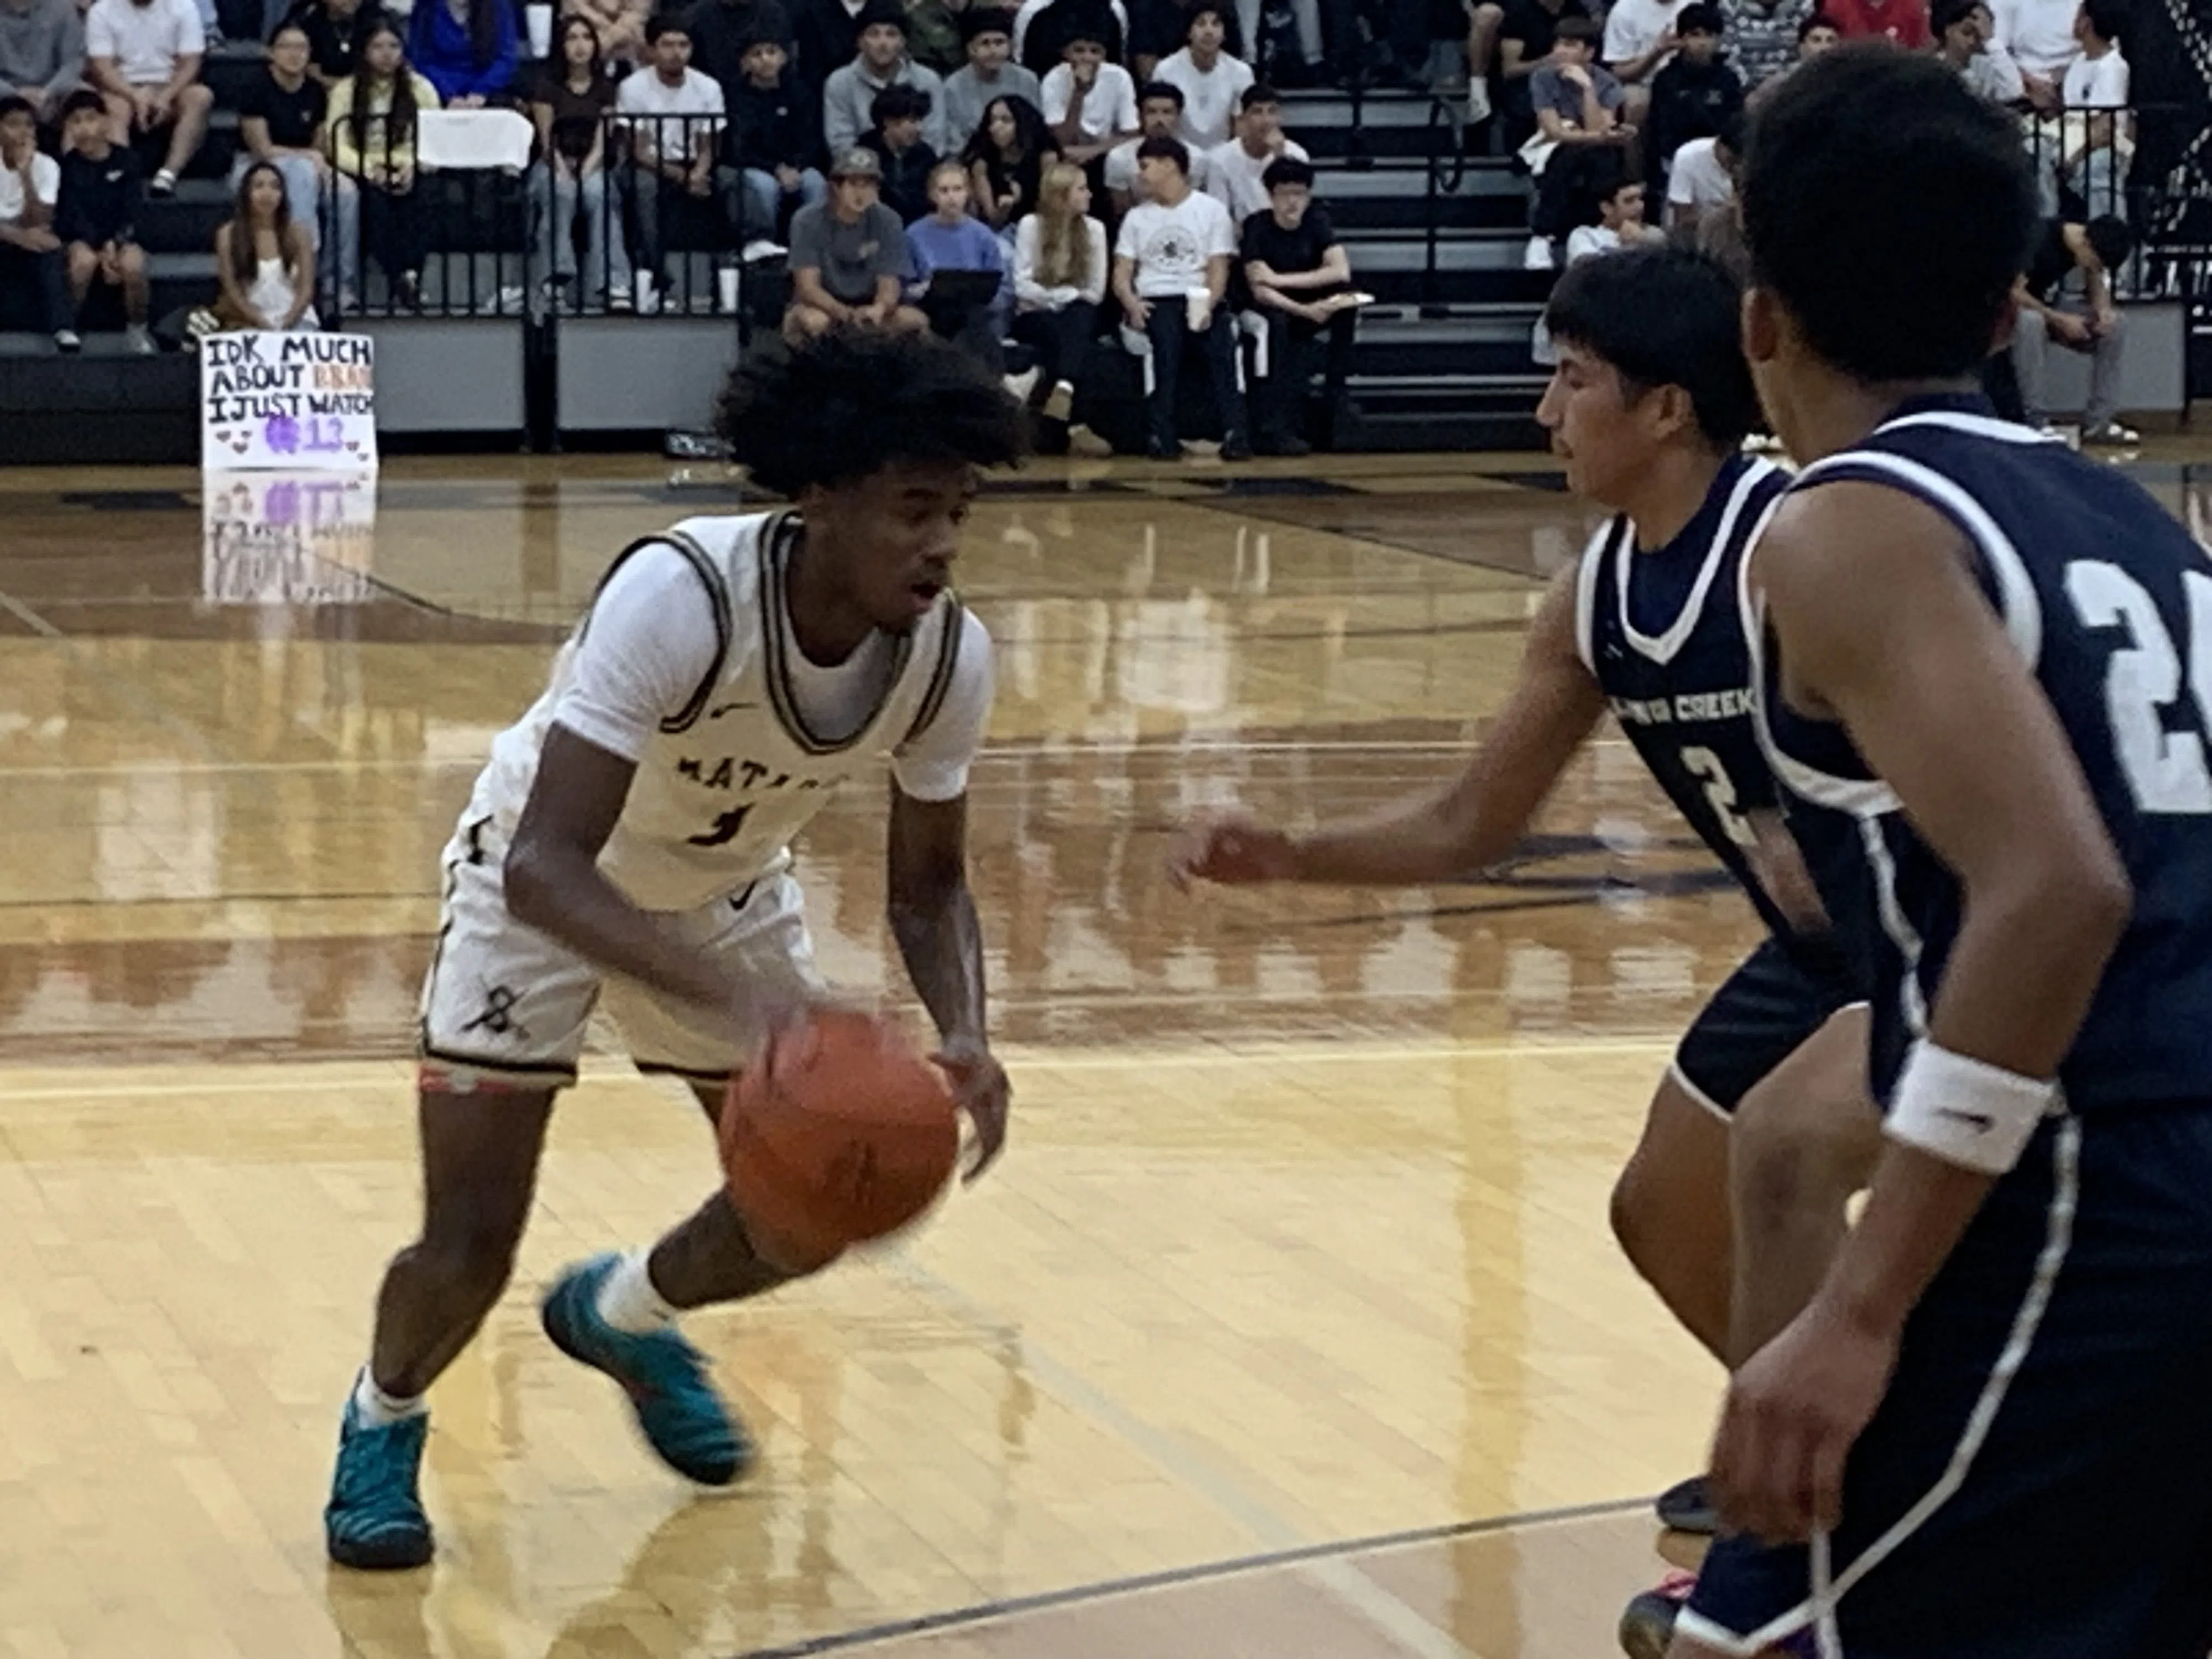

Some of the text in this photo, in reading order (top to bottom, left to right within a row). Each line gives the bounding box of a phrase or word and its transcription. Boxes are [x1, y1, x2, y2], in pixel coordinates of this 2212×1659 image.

[206, 334, 371, 366] IDK MUCH
[211, 364, 305, 395] ABOUT
[2063, 560, 2212, 813] 2
[1678, 745, 1760, 846] 2
